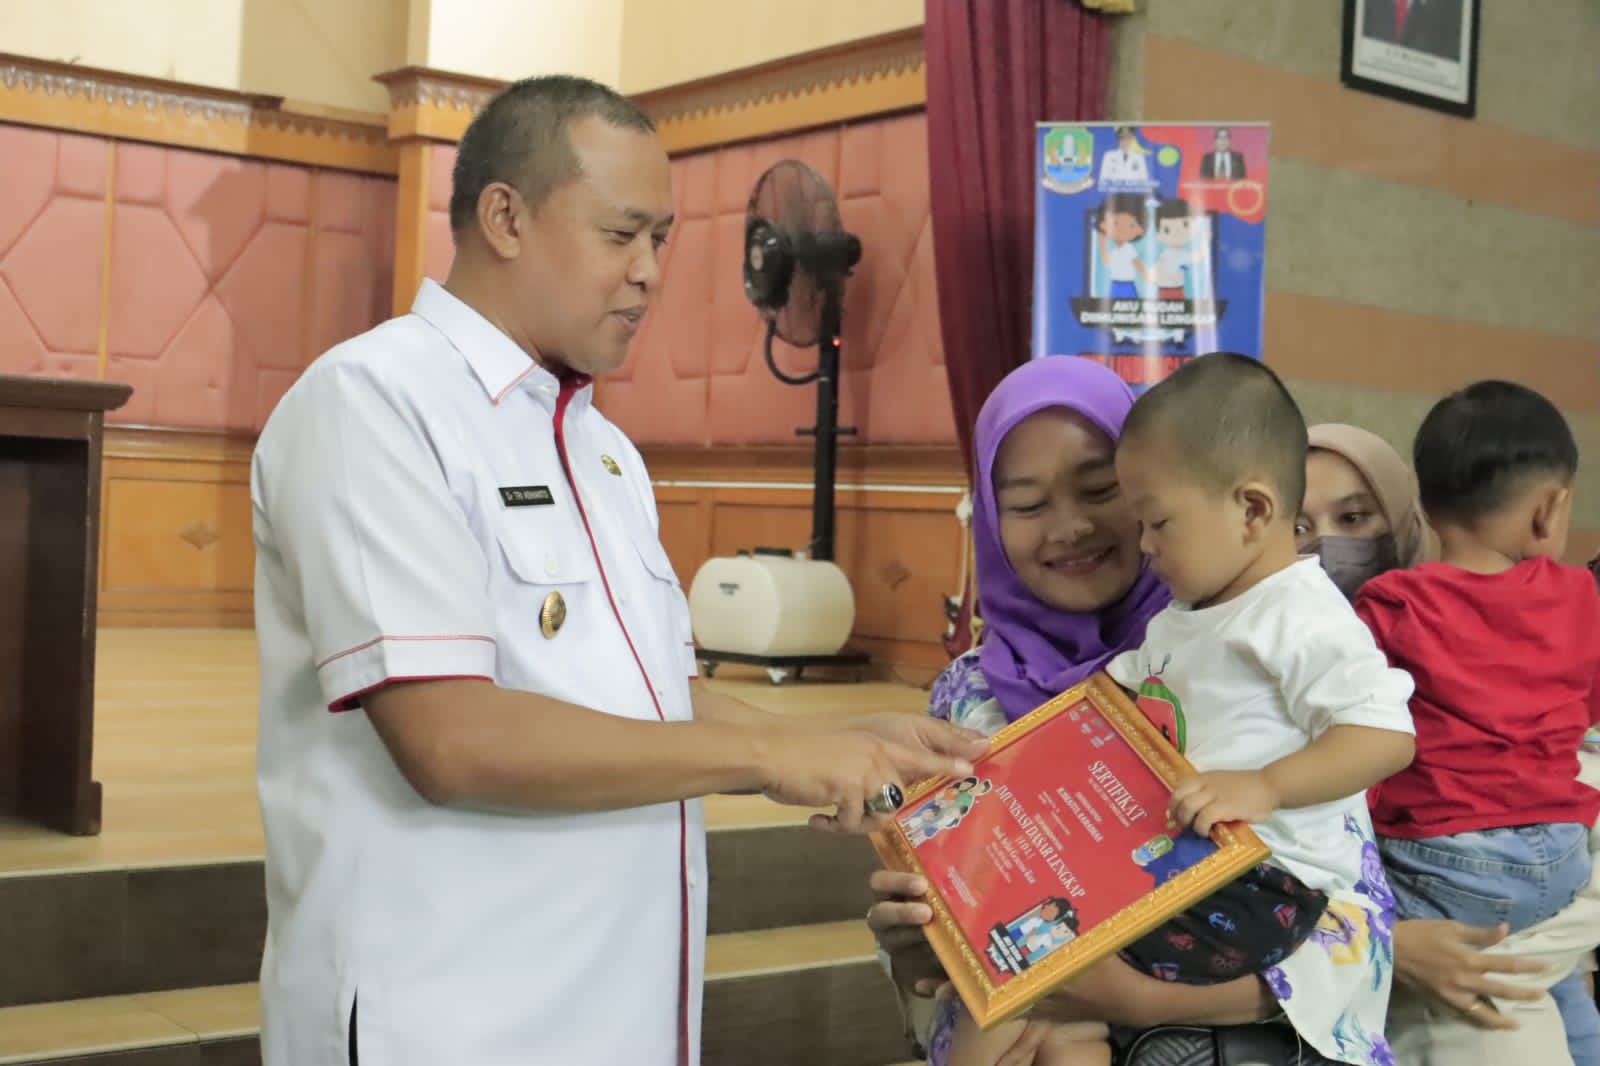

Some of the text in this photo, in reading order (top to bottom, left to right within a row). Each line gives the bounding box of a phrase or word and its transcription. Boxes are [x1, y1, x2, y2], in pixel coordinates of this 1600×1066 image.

[1088, 760, 1147, 822] SERTIFIKAT
[995, 785, 1034, 829] IMUNISASI
[1026, 824, 1054, 857] DASAR
[1046, 854, 1086, 898] LENGKAP
